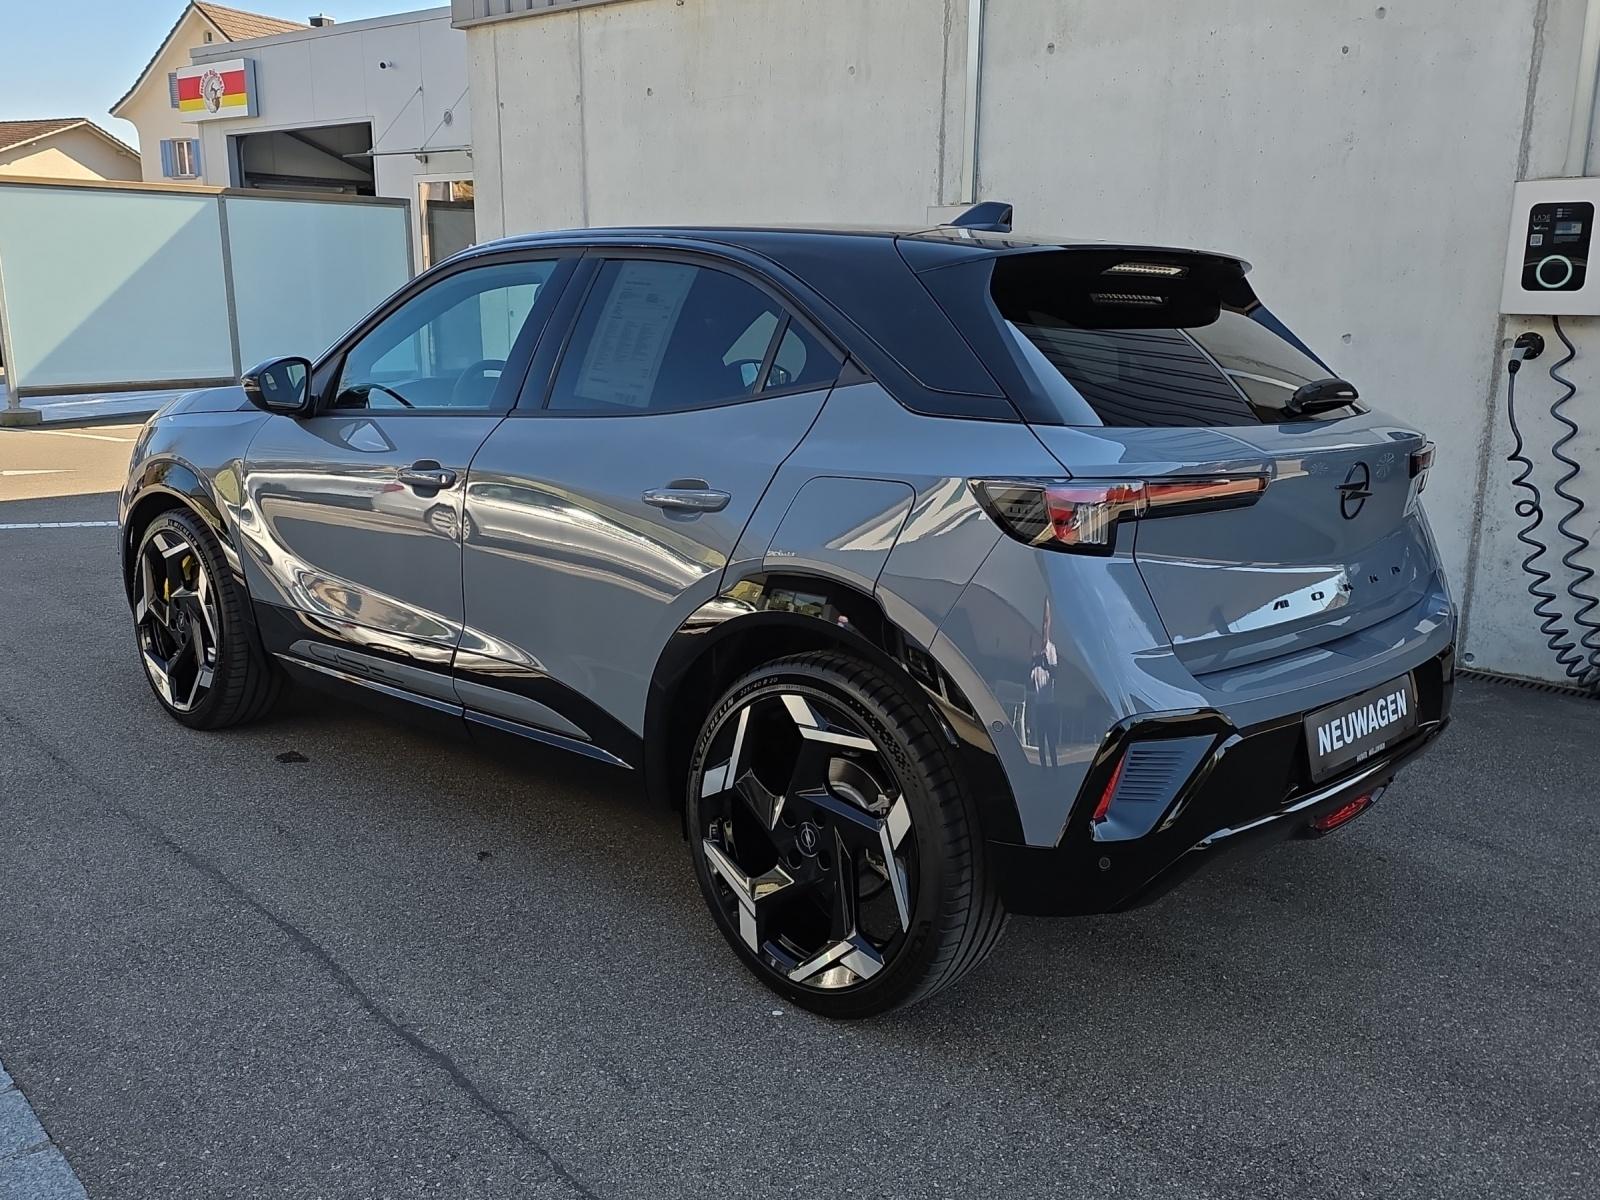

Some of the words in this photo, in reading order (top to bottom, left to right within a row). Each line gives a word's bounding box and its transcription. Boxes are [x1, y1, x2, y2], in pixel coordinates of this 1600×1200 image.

[1273, 566, 1401, 611] MOKKA
[699, 697, 735, 754] MICHELIN
[1317, 688, 1407, 757] NEUWAGEN
